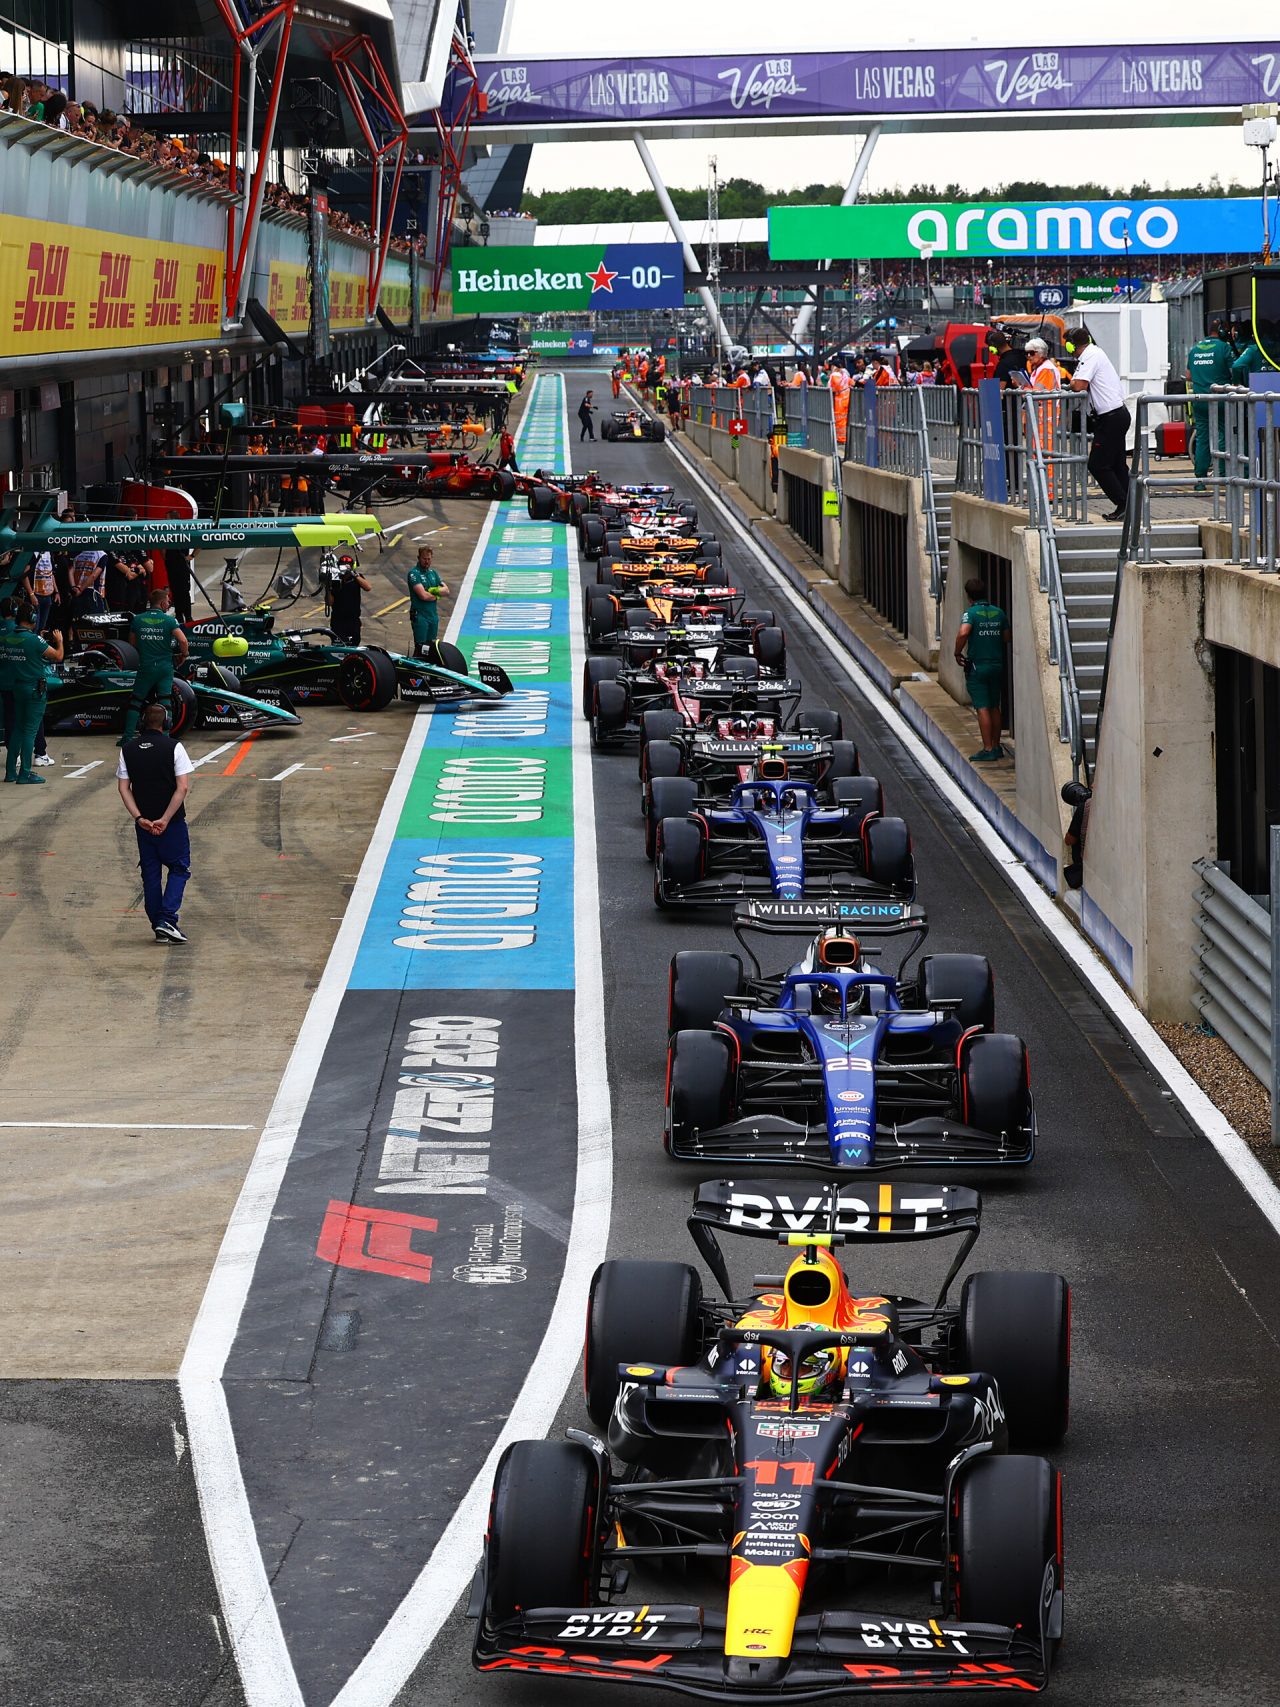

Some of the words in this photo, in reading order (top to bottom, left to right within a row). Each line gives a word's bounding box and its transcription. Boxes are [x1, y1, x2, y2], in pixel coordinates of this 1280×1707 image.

[766, 59, 792, 76] LAS
[1032, 53, 1058, 70] LAS
[502, 68, 526, 84] LAS
[718, 64, 807, 109] Vegas
[856, 68, 880, 99] LAS
[883, 66, 935, 98] VEGAS
[984, 57, 1072, 104] Vegas
[1122, 61, 1147, 93] LAS
[1150, 59, 1202, 91] VEGAS
[589, 74, 615, 105] LAS
[616, 72, 669, 104] VEGAS
[907, 206, 1179, 251] aramco
[22, 242, 70, 331] DHL
[95, 251, 132, 328] DHL
[150, 258, 179, 326] DHL
[458, 269, 584, 293] Heineken
[1077, 285, 1113, 294] Heineken
[193, 263, 217, 324] DHL
[532, 340, 566, 349] Heineken
[47, 534, 98, 546] cognizant
[109, 534, 146, 544] ASTON
[148, 532, 191, 543] MARTIN
[202, 532, 245, 541] aramco
[192, 624, 244, 636] aramco
[632, 632, 655, 640] Stake
[686, 632, 709, 640] Stake
[695, 680, 721, 690] Stake
[757, 680, 784, 690] Stake
[708, 743, 758, 751] WILLIAM
[428, 757, 549, 823] aramco
[776, 835, 793, 844] 2
[392, 853, 544, 951] aramco
[840, 906, 901, 915] RACING
[826, 1057, 873, 1072] 23
[744, 1461, 816, 1486] 11
